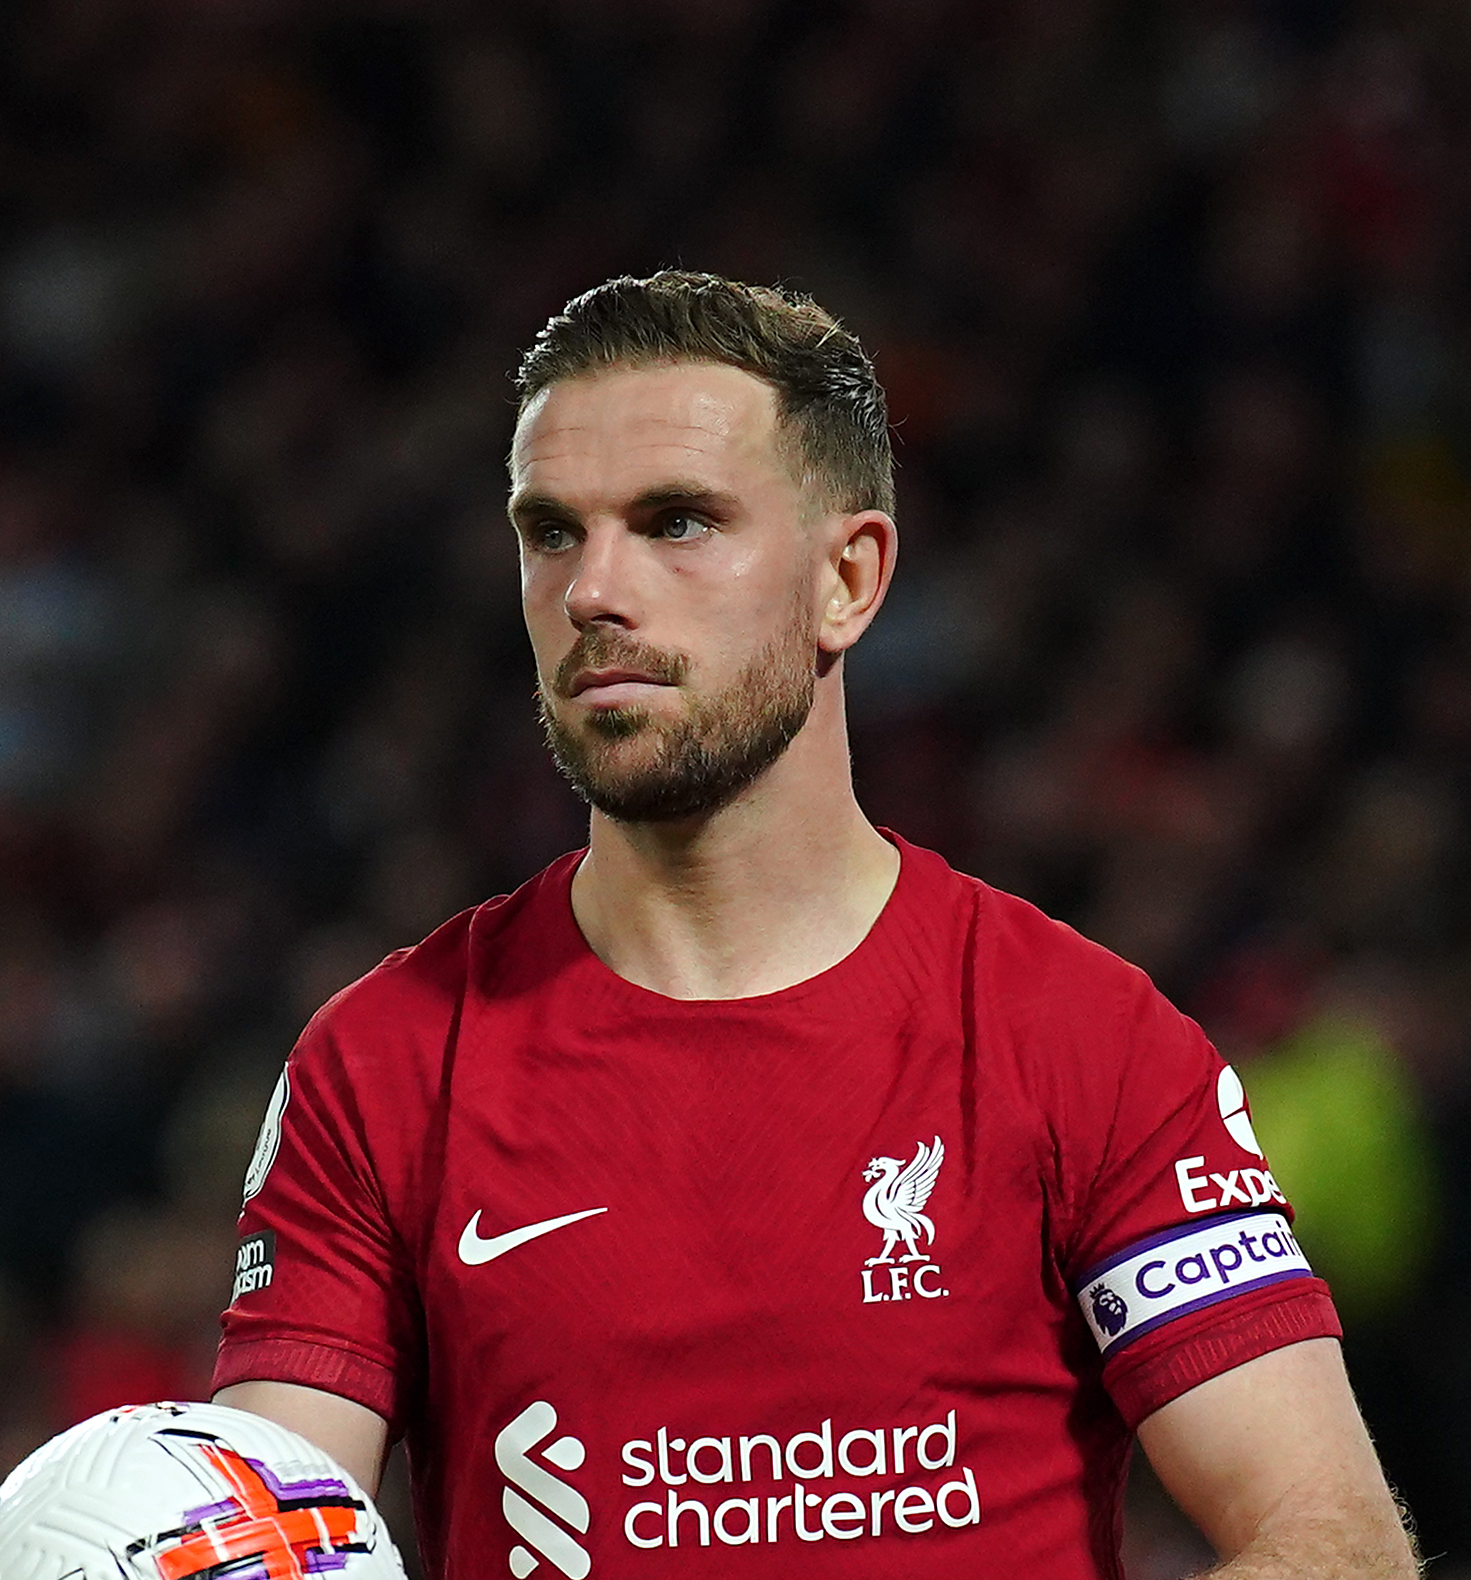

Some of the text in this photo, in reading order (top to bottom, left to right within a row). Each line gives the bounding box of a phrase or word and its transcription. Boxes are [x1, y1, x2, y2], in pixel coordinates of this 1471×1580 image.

[860, 1264, 950, 1304] L.F.C.
[621, 1409, 956, 1487] standard
[624, 1466, 980, 1549] chartered
